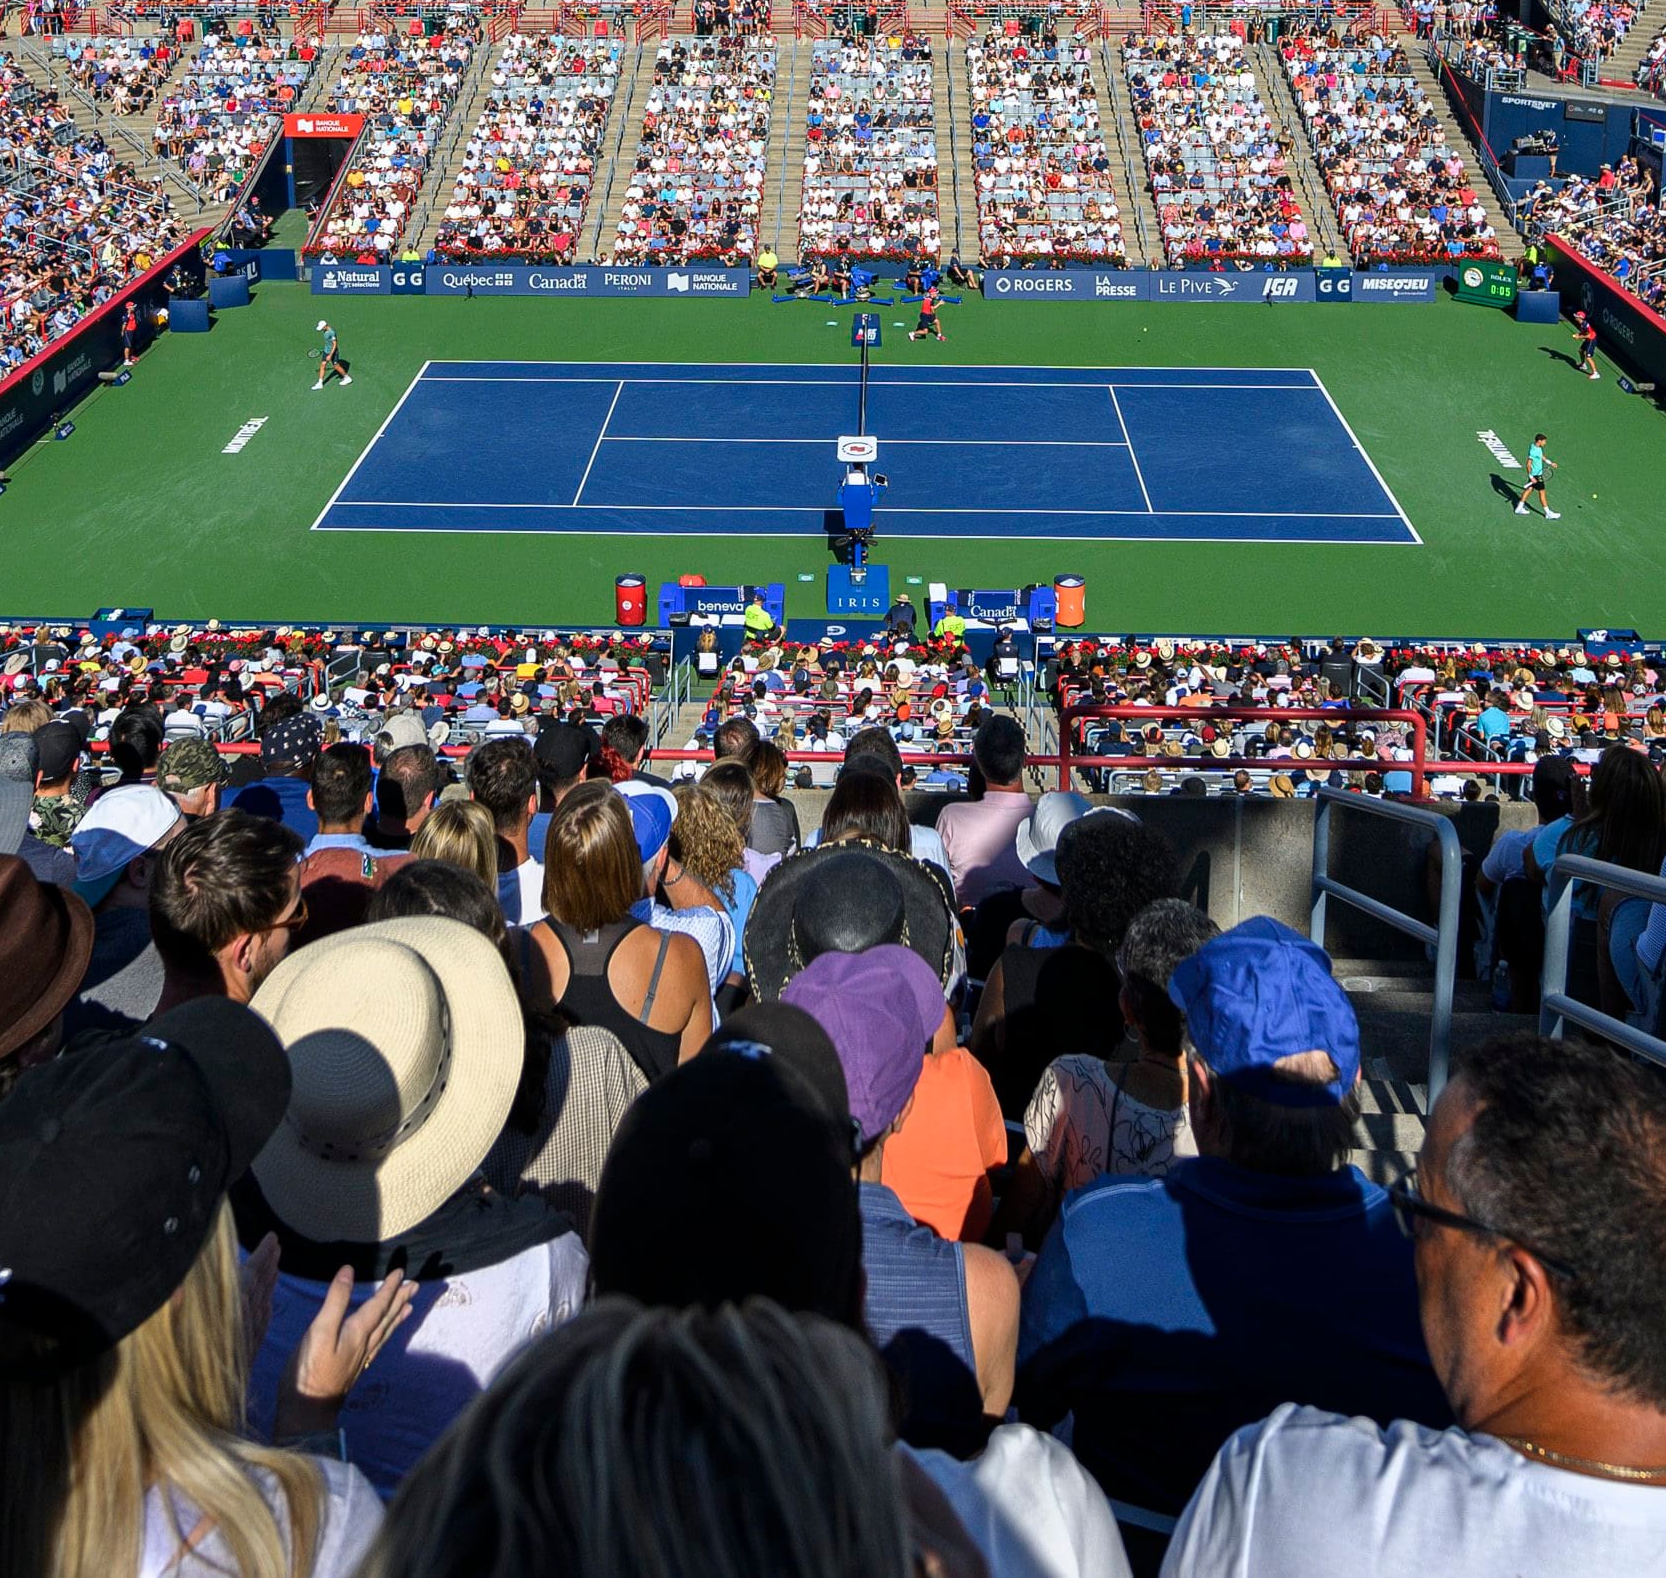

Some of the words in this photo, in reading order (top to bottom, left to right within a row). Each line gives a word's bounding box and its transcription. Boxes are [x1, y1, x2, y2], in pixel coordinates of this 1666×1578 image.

[1501, 96, 1557, 109] SPORTSNET
[337, 271, 379, 282] Natural
[443, 272, 493, 288] Québec
[529, 273, 587, 289] Canada
[604, 273, 652, 286] PERONI
[693, 274, 726, 282] BANQUE
[1096, 275, 1111, 285] LA
[1490, 274, 1512, 283] ROLEX
[693, 282, 738, 291] NATIONALE
[1014, 278, 1073, 292] ROGERS
[1096, 285, 1136, 296] PRESSE
[1263, 277, 1299, 296] IGA
[1490, 284, 1511, 297] 0:05
[1610, 313, 1635, 344] ROGERS
[66, 353, 85, 374] BANQUE
[67, 358, 92, 384] NATIONALE
[221, 416, 270, 454] MONTRÉAL
[1476, 429, 1522, 468] MONTRÉAL
[697, 600, 744, 612] beneva
[838, 597, 880, 608] IRIS
[970, 604, 1017, 617] Canada
